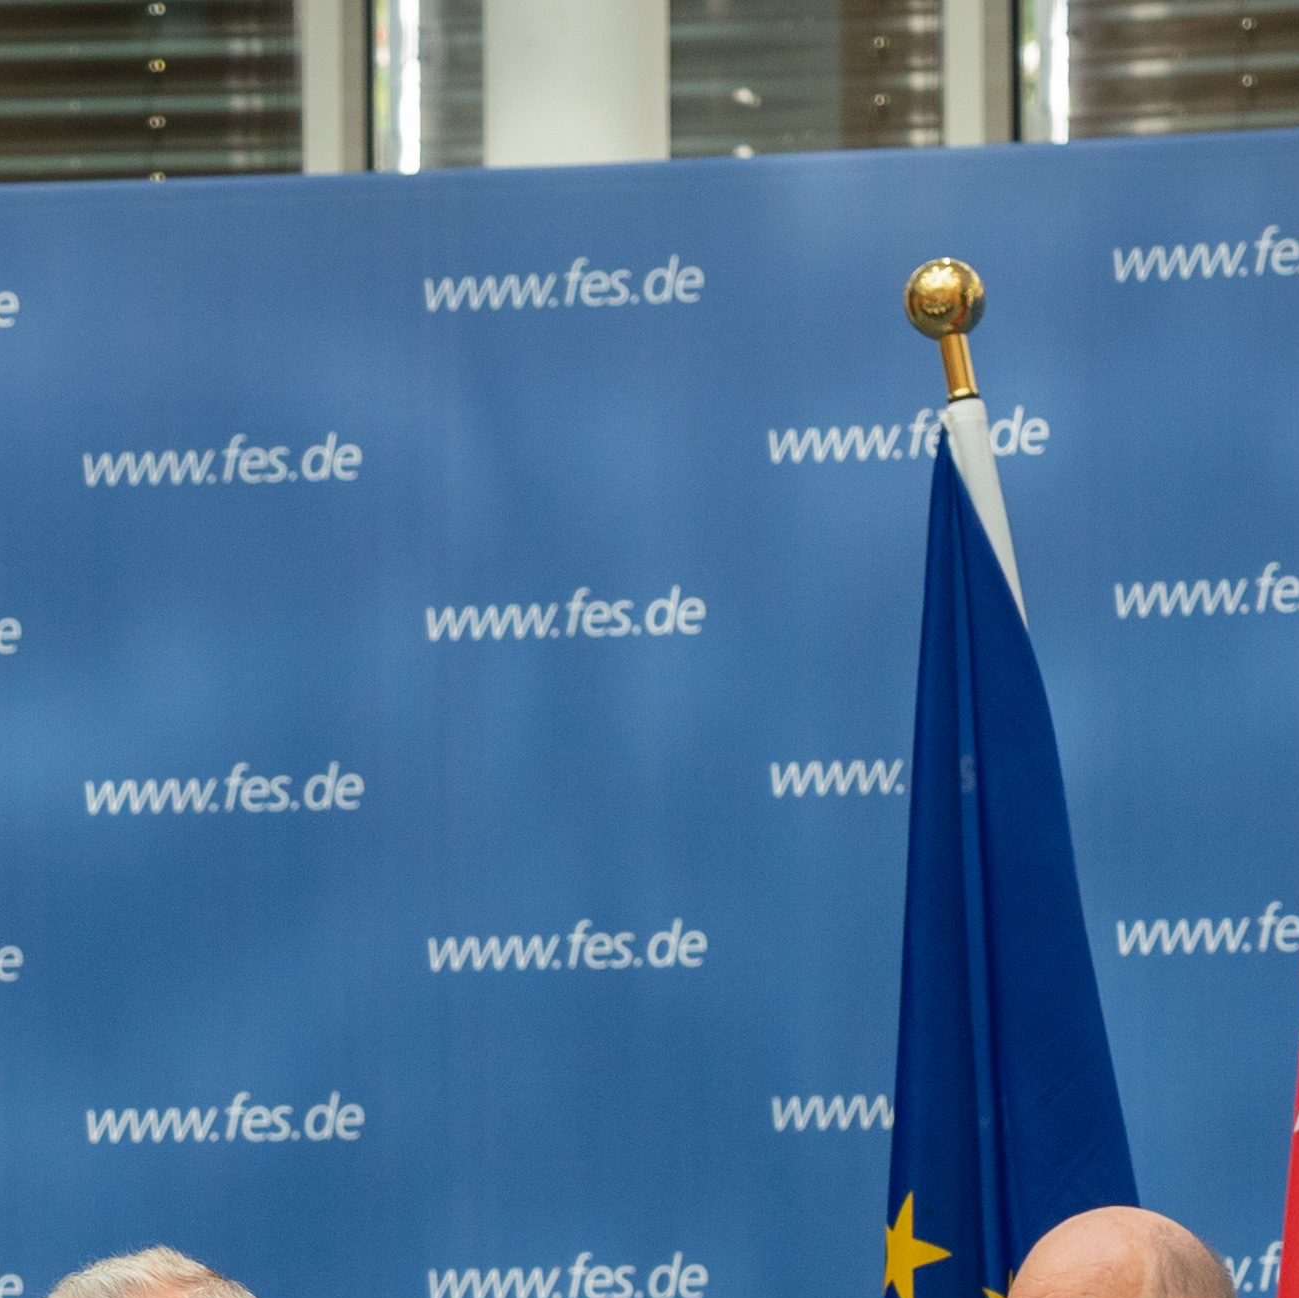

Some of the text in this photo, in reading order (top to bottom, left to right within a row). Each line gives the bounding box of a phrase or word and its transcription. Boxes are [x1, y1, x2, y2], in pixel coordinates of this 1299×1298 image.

[424, 255, 704, 312] www.fes.de
[83, 431, 362, 487] www.fes.de
[425, 584, 706, 642] www.fes.de
[85, 761, 365, 815] www.fes.de
[428, 918, 707, 972] www.fes.de
[86, 1091, 365, 1144] www.fes.de
